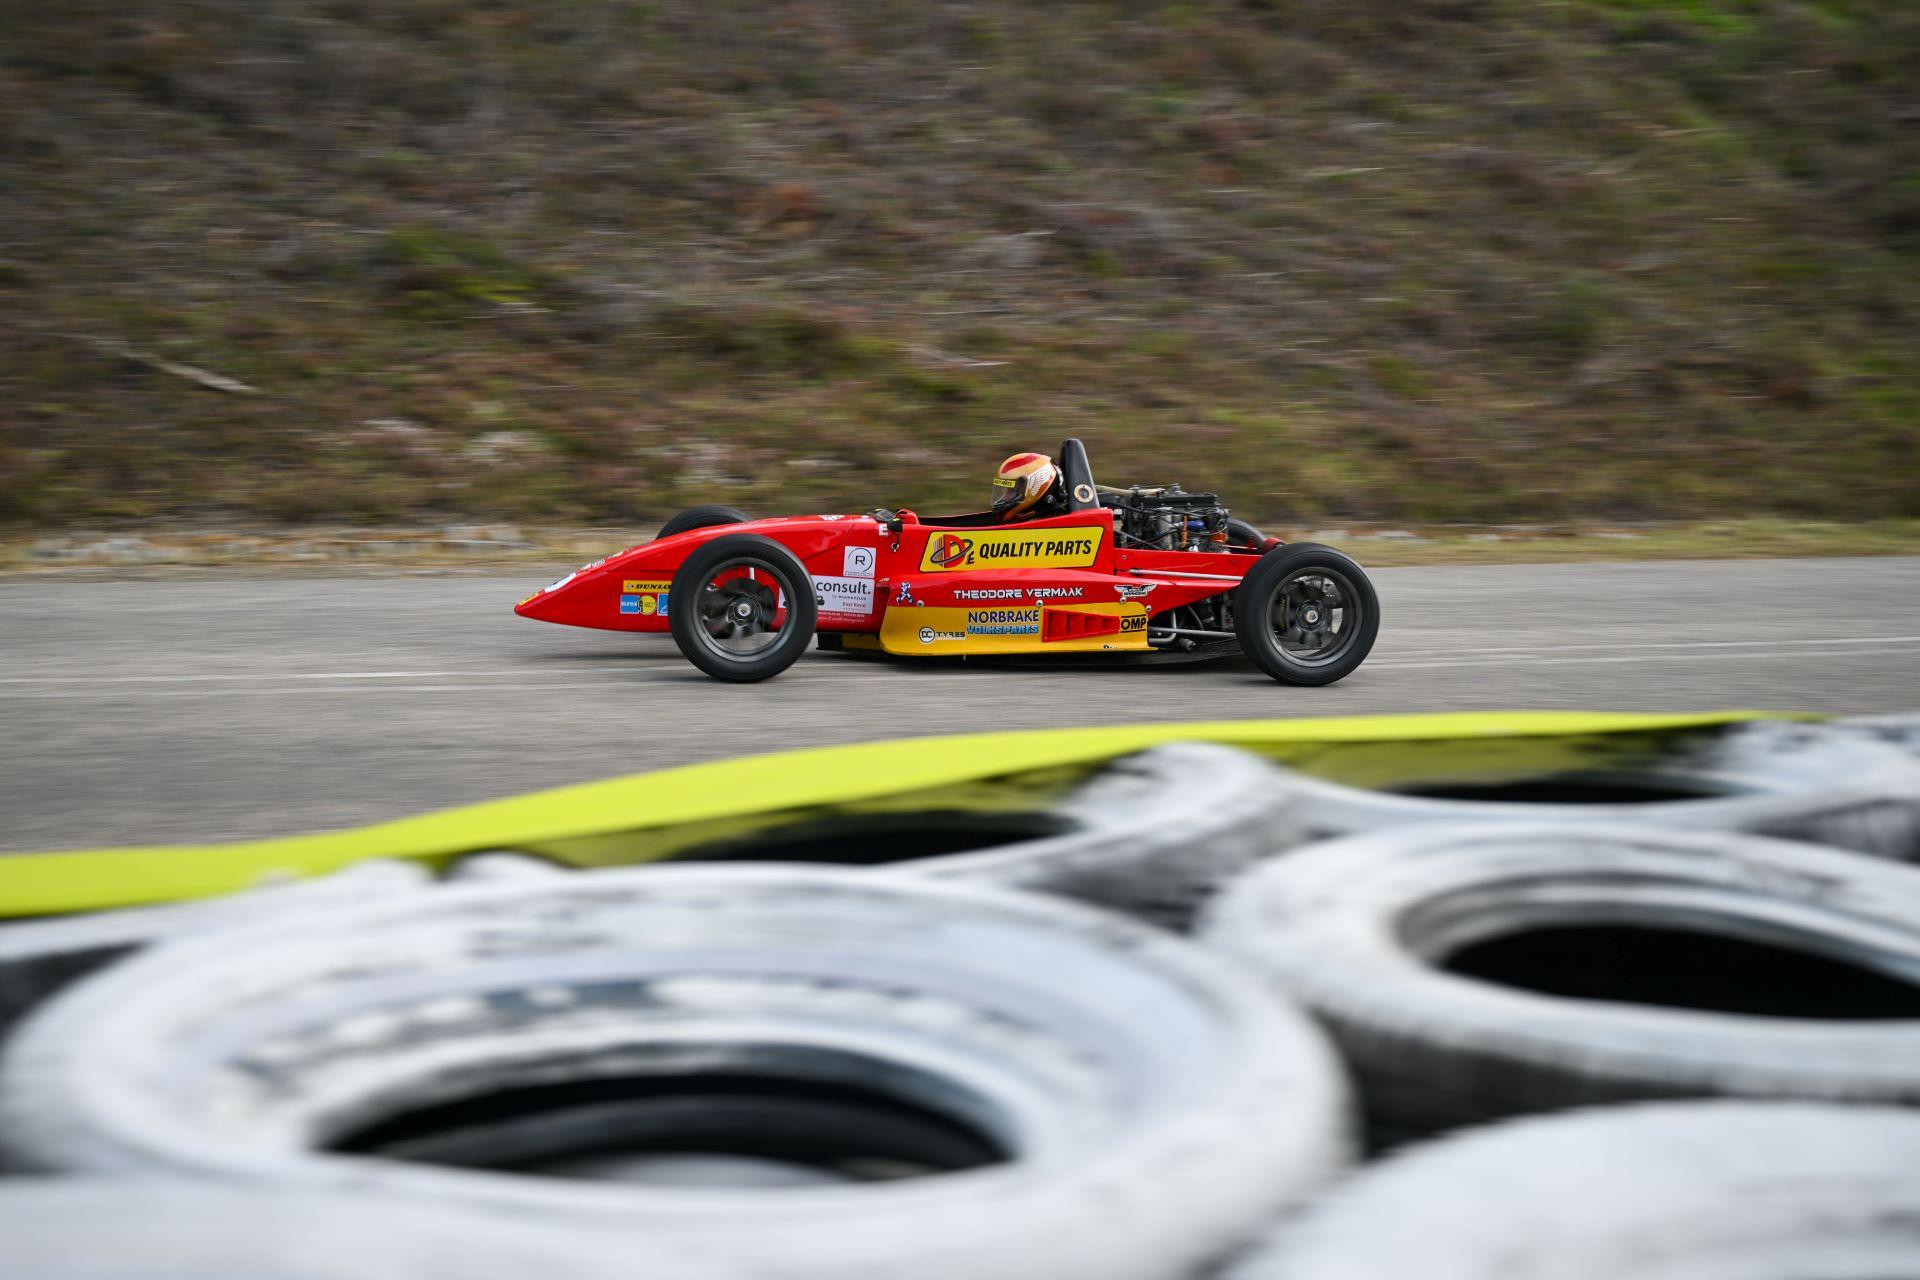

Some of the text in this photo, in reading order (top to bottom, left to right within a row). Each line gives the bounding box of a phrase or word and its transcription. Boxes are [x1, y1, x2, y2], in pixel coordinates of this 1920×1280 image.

[979, 540, 1092, 558] QUALITY PARTS
[855, 555, 866, 566] R
[816, 581, 871, 595] consult.
[953, 587, 1083, 599] THEODORE VERMAAK
[968, 610, 1039, 623] NORBRAKE
[967, 625, 1039, 635] VOLKSPARES
[1121, 618, 1147, 630] OMP
